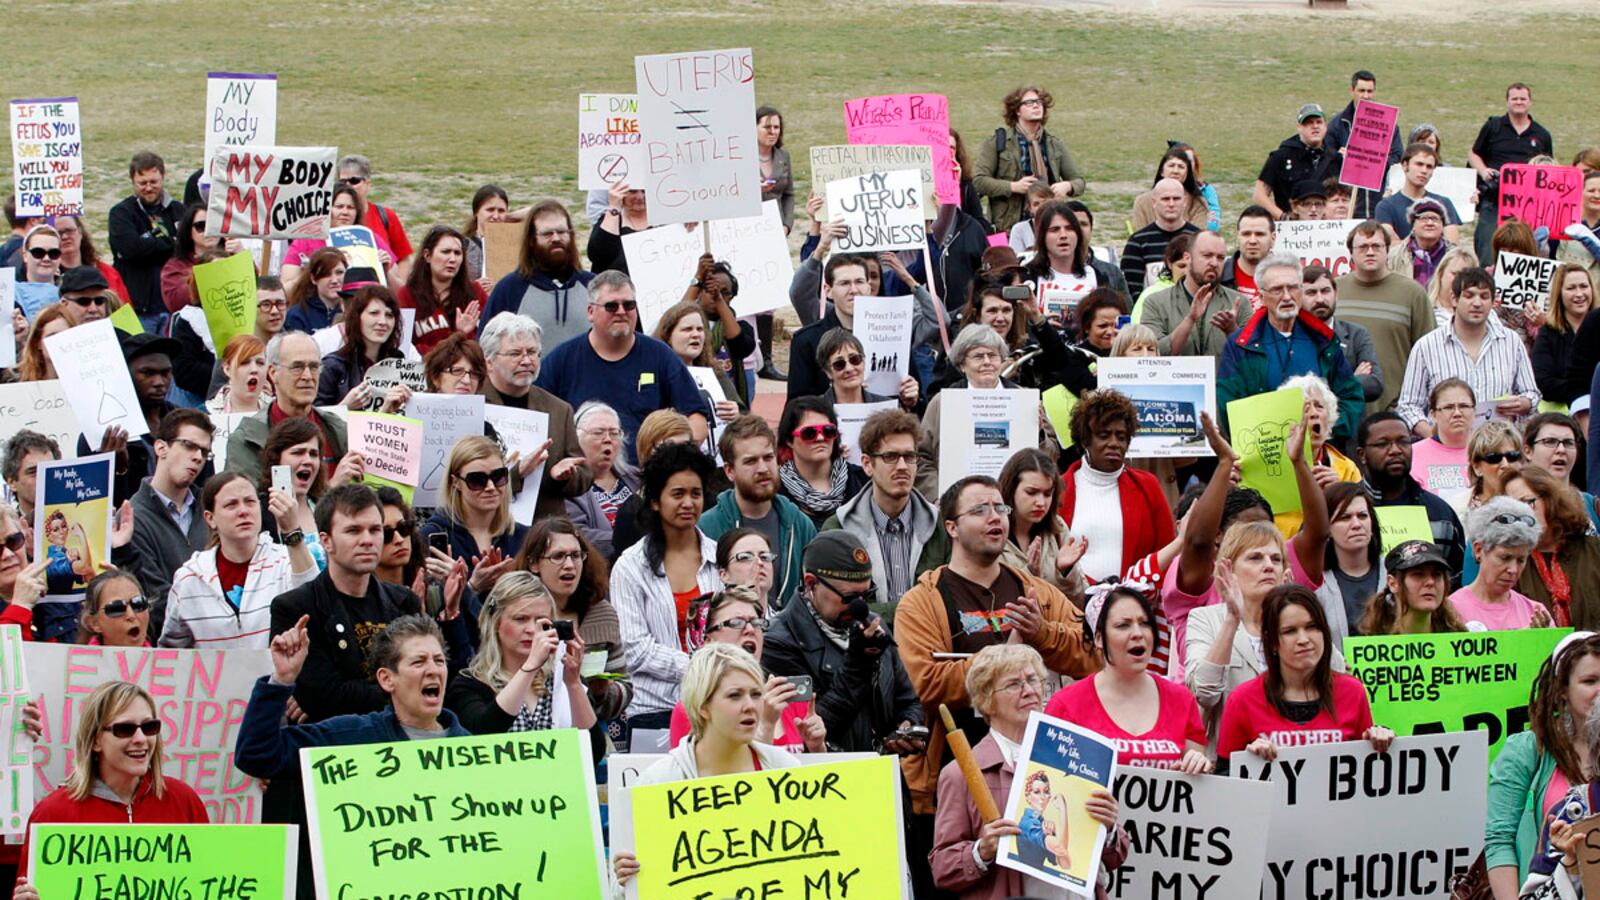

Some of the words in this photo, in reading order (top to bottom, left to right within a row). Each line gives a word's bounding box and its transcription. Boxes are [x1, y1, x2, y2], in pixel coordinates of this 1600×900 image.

[643, 53, 754, 97] UTERUS
[222, 82, 256, 105] MY
[17, 105, 36, 118] IF
[41, 104, 64, 117] THE
[581, 95, 598, 112] I
[17, 123, 51, 139] FETUS
[53, 122, 75, 138] YOU
[213, 106, 259, 140] Body
[606, 117, 640, 133] LIKE
[648, 135, 743, 174] BATTLE
[20, 162, 48, 175] WILL
[49, 161, 69, 173] YOU
[226, 153, 274, 185] MY
[278, 158, 333, 188] BODY
[19, 178, 53, 191] STILL
[656, 172, 740, 208] Ground
[859, 173, 888, 192] MY
[21, 192, 43, 207] FOR
[841, 188, 917, 213] UTERUS
[221, 186, 280, 235] MY
[272, 190, 332, 231] CHOICE
[865, 210, 889, 226] MY
[1291, 224, 1313, 235] you
[1283, 237, 1312, 249] trust
[1510, 278, 1550, 293] ARE
[416, 406, 431, 415] Not
[455, 405, 475, 416] back
[368, 421, 406, 437] TRUST
[363, 434, 409, 453] WOMEN
[54, 469, 63, 481] My
[376, 458, 409, 477] Decide
[65, 479, 74, 491] My
[77, 490, 85, 500] My
[1353, 642, 1435, 663] FORCING
[1450, 637, 1498, 658] YOUR
[66, 646, 225, 698] EVEN
[1352, 664, 1425, 686] AGENDA
[1431, 663, 1517, 685] BETWEEN
[1367, 685, 1379, 703] Y
[1389, 683, 1440, 702] LEGS
[1046, 727, 1057, 742] My
[1057, 743, 1068, 757] My
[1112, 738, 1181, 754] OTHER
[312, 754, 358, 785] THE
[375, 746, 400, 778] 3
[1068, 760, 1079, 774] My
[1328, 745, 1460, 801] BODY
[666, 780, 752, 819] KEEP
[766, 772, 847, 804] YOUR
[1112, 773, 1194, 814] YOUR
[368, 837, 431, 867] FOR
[439, 831, 502, 854] THE
[671, 818, 825, 873] AGENDA
[1304, 847, 1470, 900] CHOICE
[200, 875, 258, 900] THE
[804, 868, 860, 900] MY
[1151, 871, 1221, 900] MY
